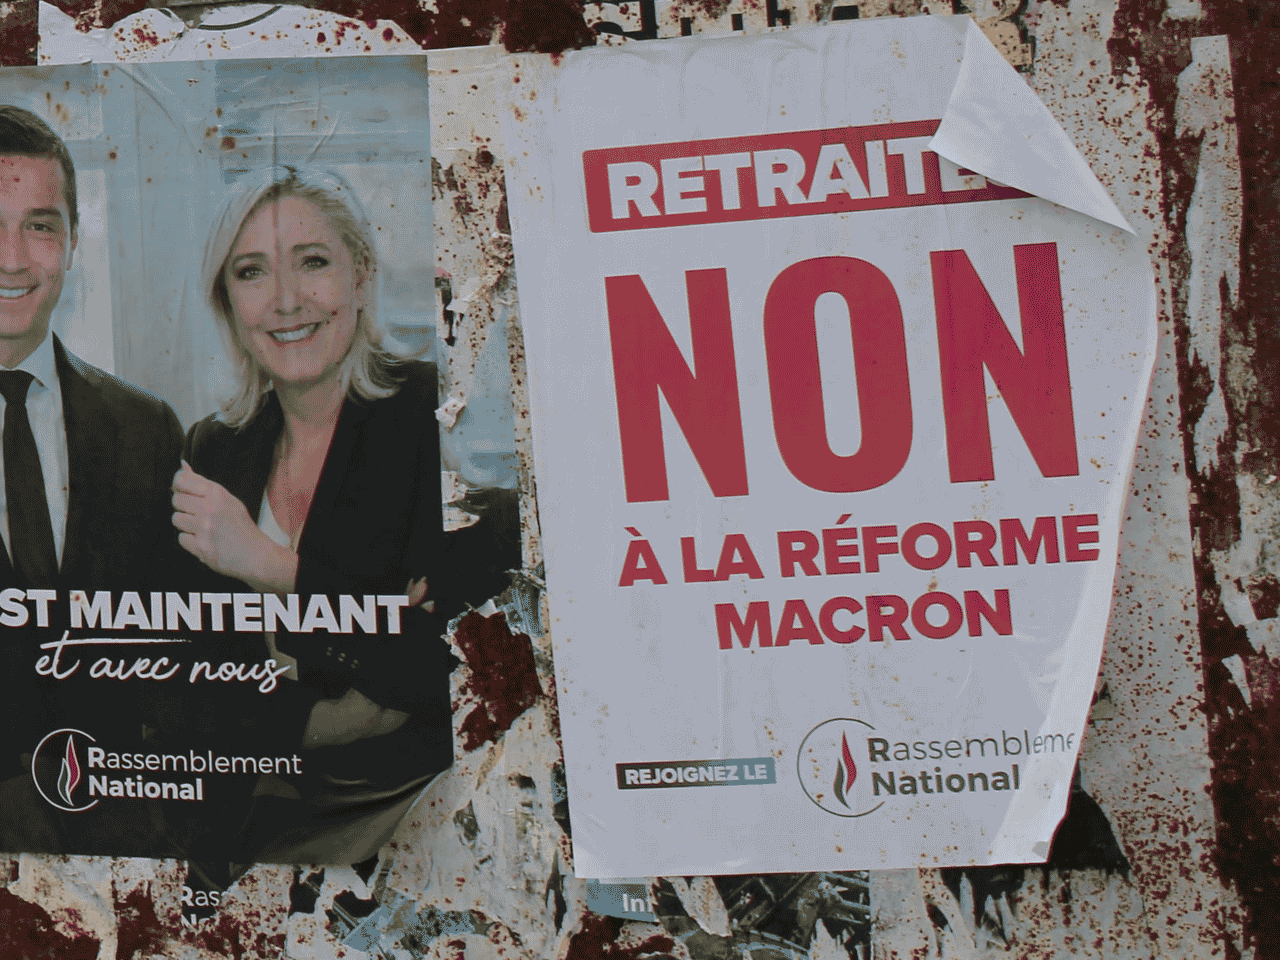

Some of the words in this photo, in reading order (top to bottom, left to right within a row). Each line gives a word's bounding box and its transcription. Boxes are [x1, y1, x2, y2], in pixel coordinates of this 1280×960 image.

[607, 136, 1010, 220] RETRAITE
[605, 242, 1080, 503] NON
[618, 527, 668, 587] À
[680, 533, 765, 584] LA
[777, 514, 1101, 580] RÉFORME
[70, 590, 409, 635] MAINTENANT
[715, 588, 1014, 650] MACRON
[35, 631, 80, 680] et
[89, 651, 180, 681] avec
[189, 651, 291, 693] nous
[87, 746, 303, 776] Rassemblement
[88, 774, 204, 801] National
[624, 765, 740, 785] REJOIGNEZ
[743, 764, 768, 781] LE
[871, 763, 1021, 797] National
